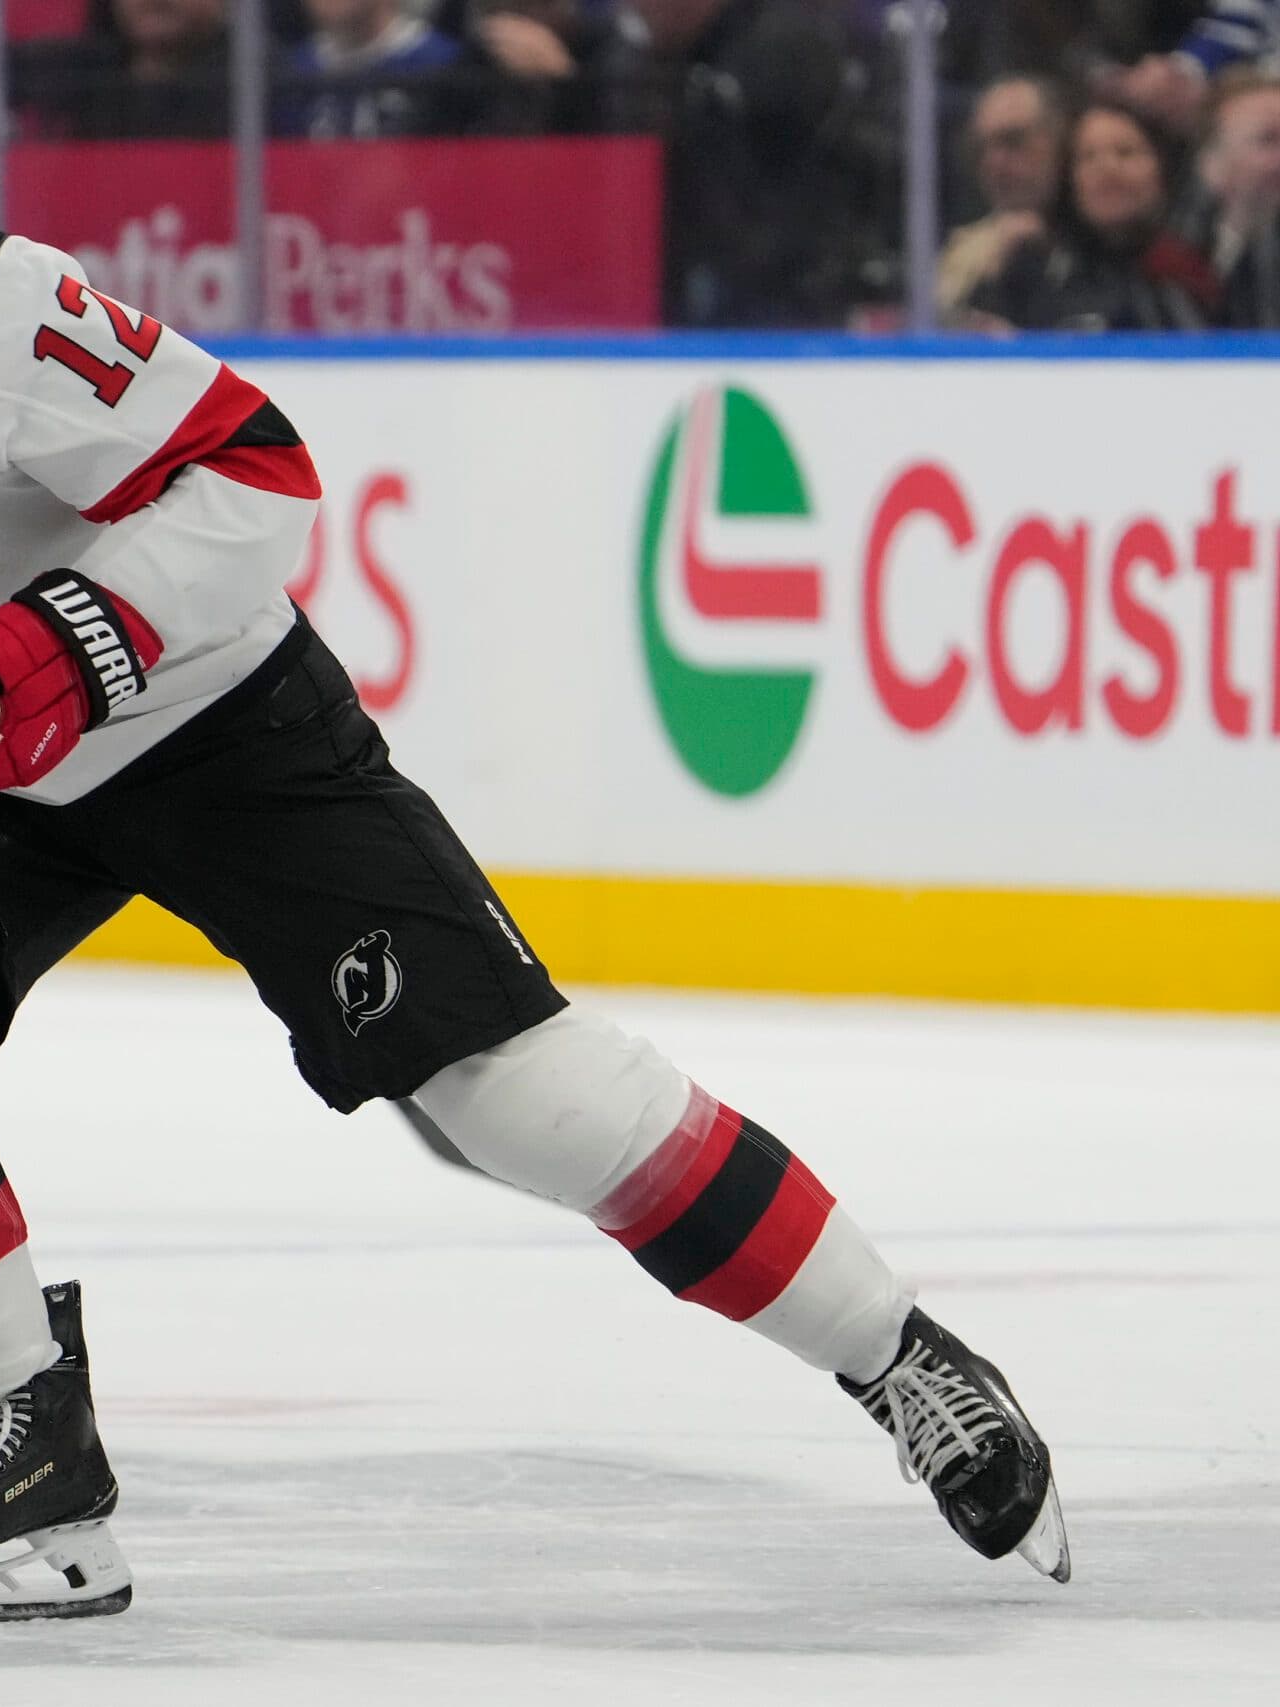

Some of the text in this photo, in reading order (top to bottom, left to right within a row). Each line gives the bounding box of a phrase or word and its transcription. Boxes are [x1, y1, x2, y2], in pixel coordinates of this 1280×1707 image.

[34, 274, 162, 409] 12
[861, 460, 1280, 738] Cast
[31, 722, 58, 765] COVERT
